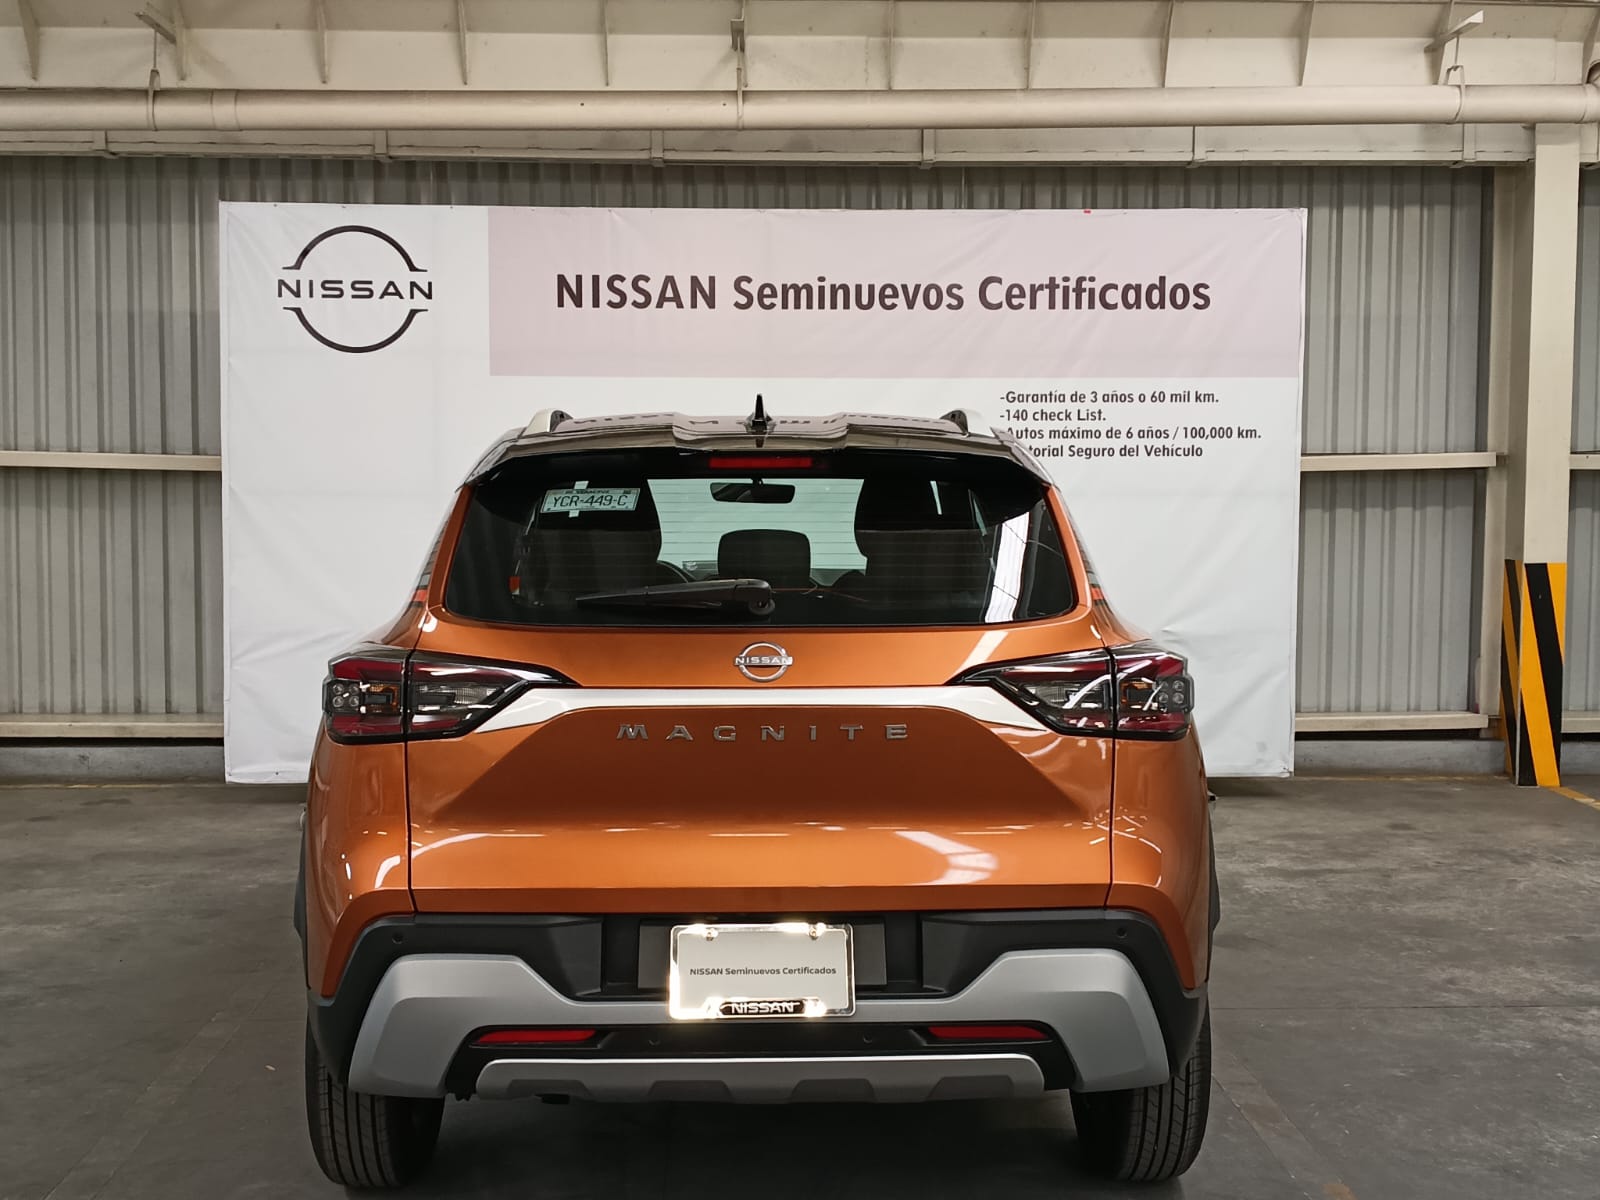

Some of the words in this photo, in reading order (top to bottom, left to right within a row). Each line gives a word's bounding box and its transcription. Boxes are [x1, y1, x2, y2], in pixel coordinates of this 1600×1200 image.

[277, 278, 433, 300] NISSAN
[556, 273, 717, 310] NISSAN
[732, 274, 966, 311] Seminuevos
[978, 274, 1212, 311] Certificados
[999, 390, 1066, 404] -Garantía
[1069, 390, 1087, 404] de
[1090, 390, 1098, 404] 3
[1101, 390, 1135, 404] años
[1138, 392, 1146, 404] o
[1150, 390, 1166, 404] 60
[1169, 390, 1191, 404] mil
[1194, 390, 1220, 404] km.
[999, 408, 1029, 422] -140
[1032, 408, 1073, 422] check
[1077, 408, 1107, 422] List.
[1048, 426, 1102, 440] máximo
[1105, 426, 1122, 440] de
[1125, 426, 1134, 440] 6
[1137, 426, 1170, 440] años
[1172, 426, 1180, 441] /
[1183, 426, 1234, 441] 100,000
[1237, 426, 1262, 440] km.
[1068, 444, 1116, 460] Seguro
[1118, 444, 1140, 458] del
[1143, 443, 1204, 458] Vehículo
[553, 494, 629, 508] YCR-449-C
[734, 656, 793, 666] NISSAN
[615, 723, 909, 742] MAGNITE
[689, 967, 724, 976] NISSAN
[725, 967, 781, 976] Seminuevos
[782, 966, 837, 975] Certificados
[730, 1001, 796, 1015] NISSAN
